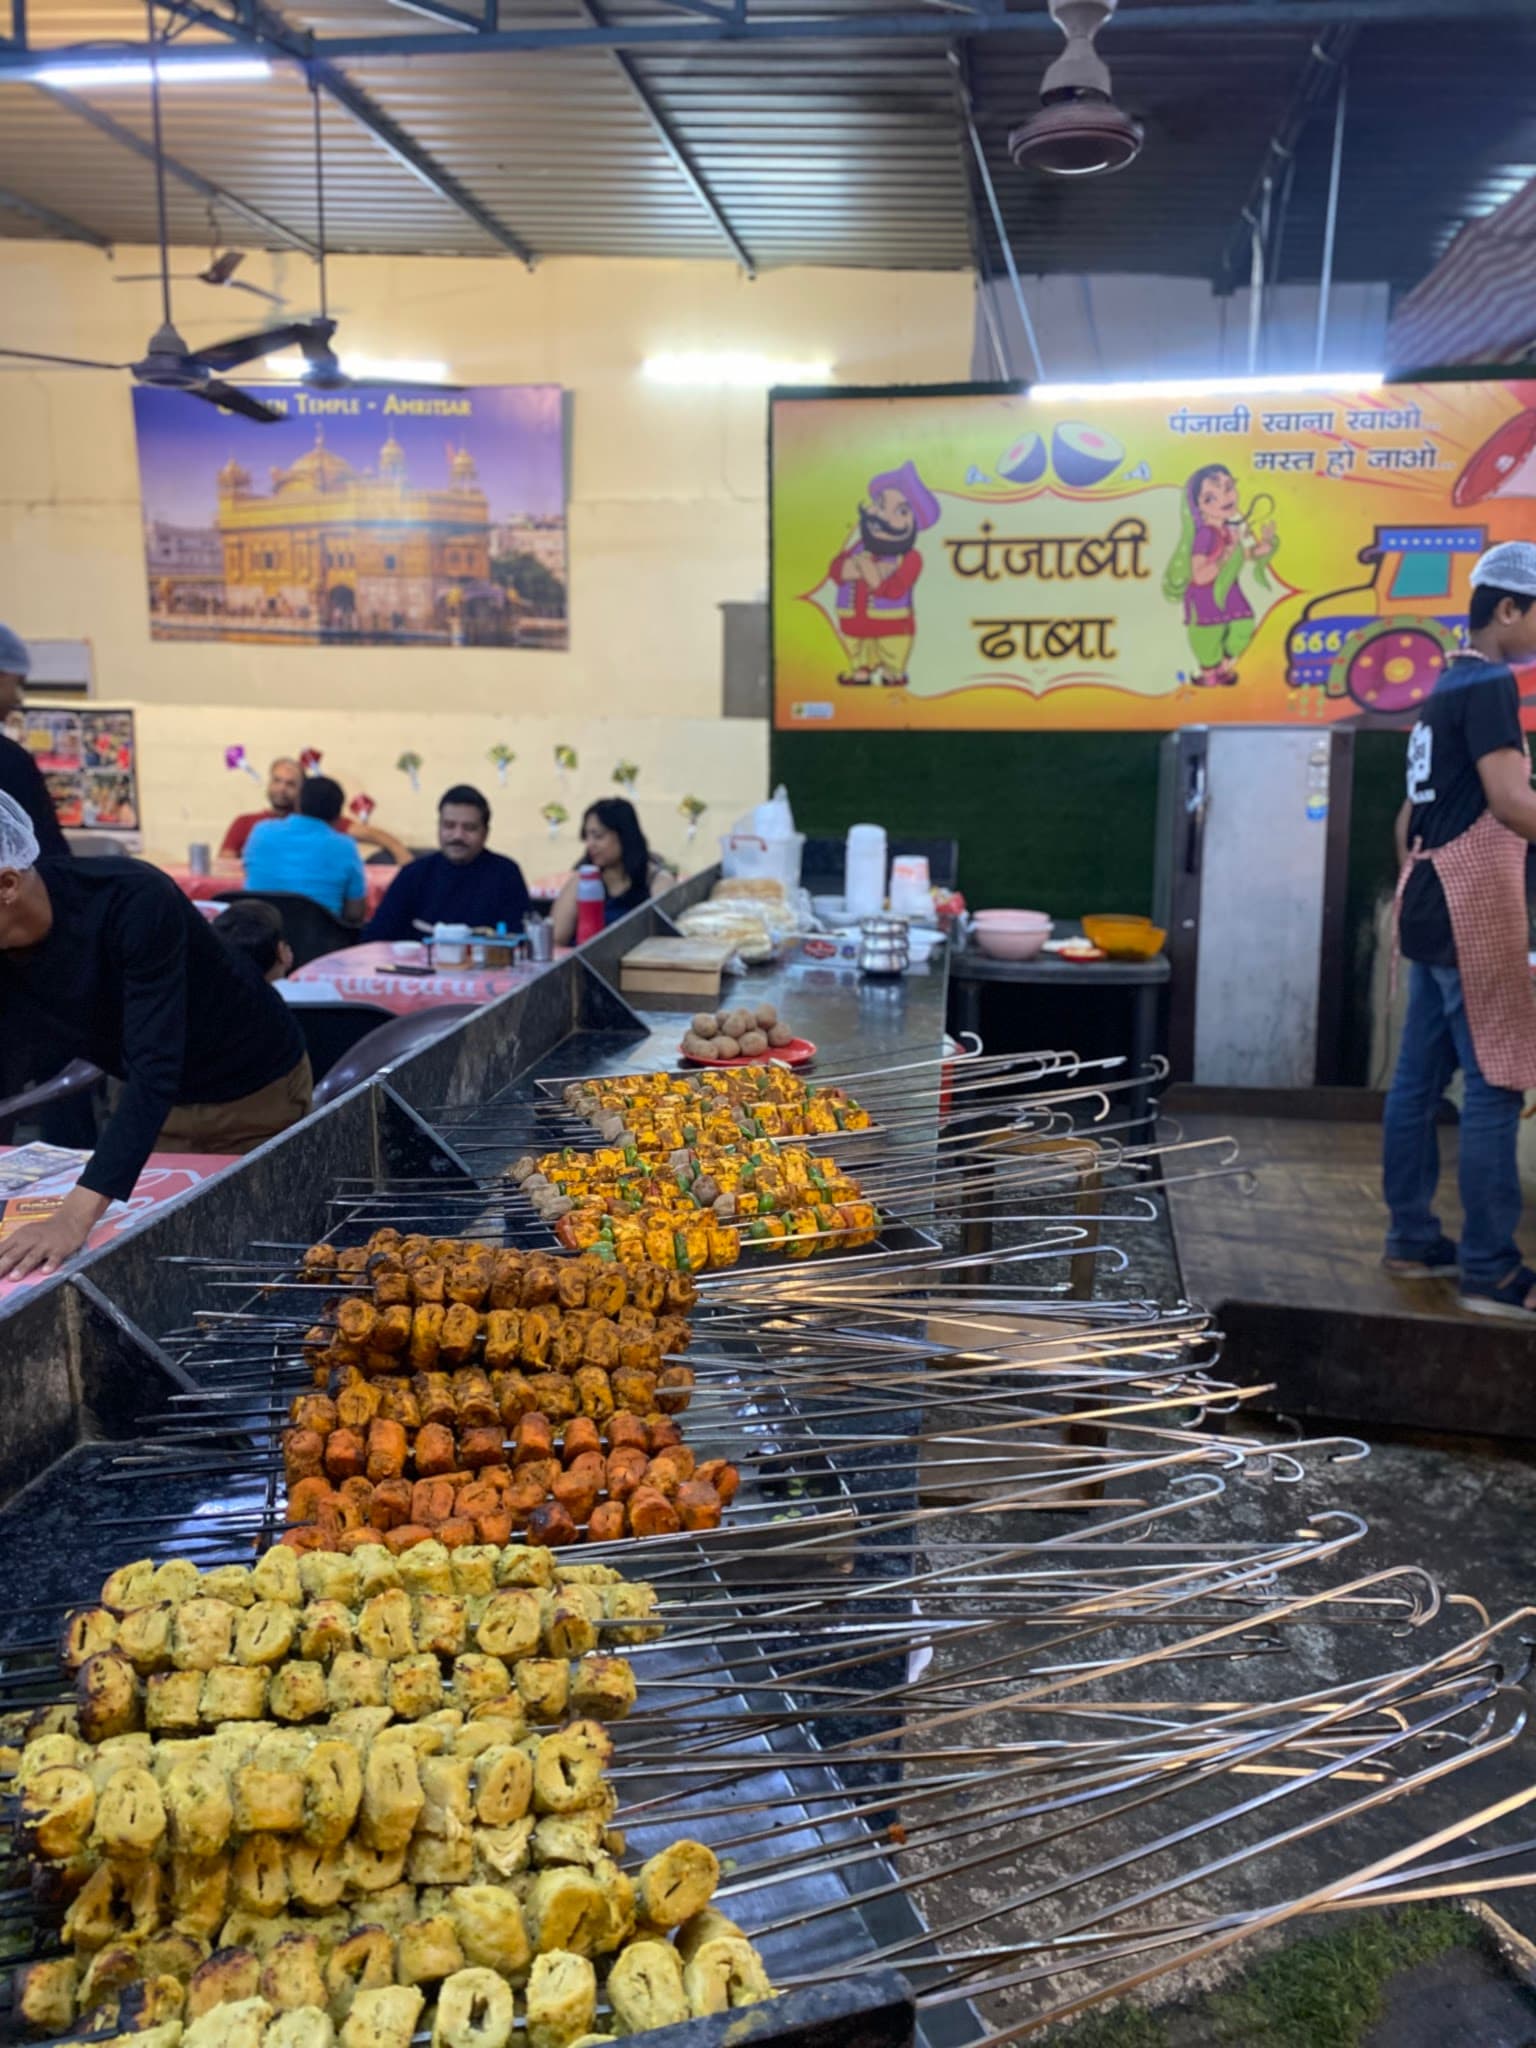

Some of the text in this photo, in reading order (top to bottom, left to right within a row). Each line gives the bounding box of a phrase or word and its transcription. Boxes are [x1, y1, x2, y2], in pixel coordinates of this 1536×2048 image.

[294, 392, 361, 416] TEMPLE
[382, 392, 473, 416] AMRITSAR
[1168, 404, 1251, 434] पंजाबी
[1261, 411, 1334, 432] खाना
[1253, 451, 1315, 471] मस्त
[1326, 440, 1356, 477] हो
[943, 516, 1151, 581] पंजाबी
[971, 616, 1117, 661] ढाबा
